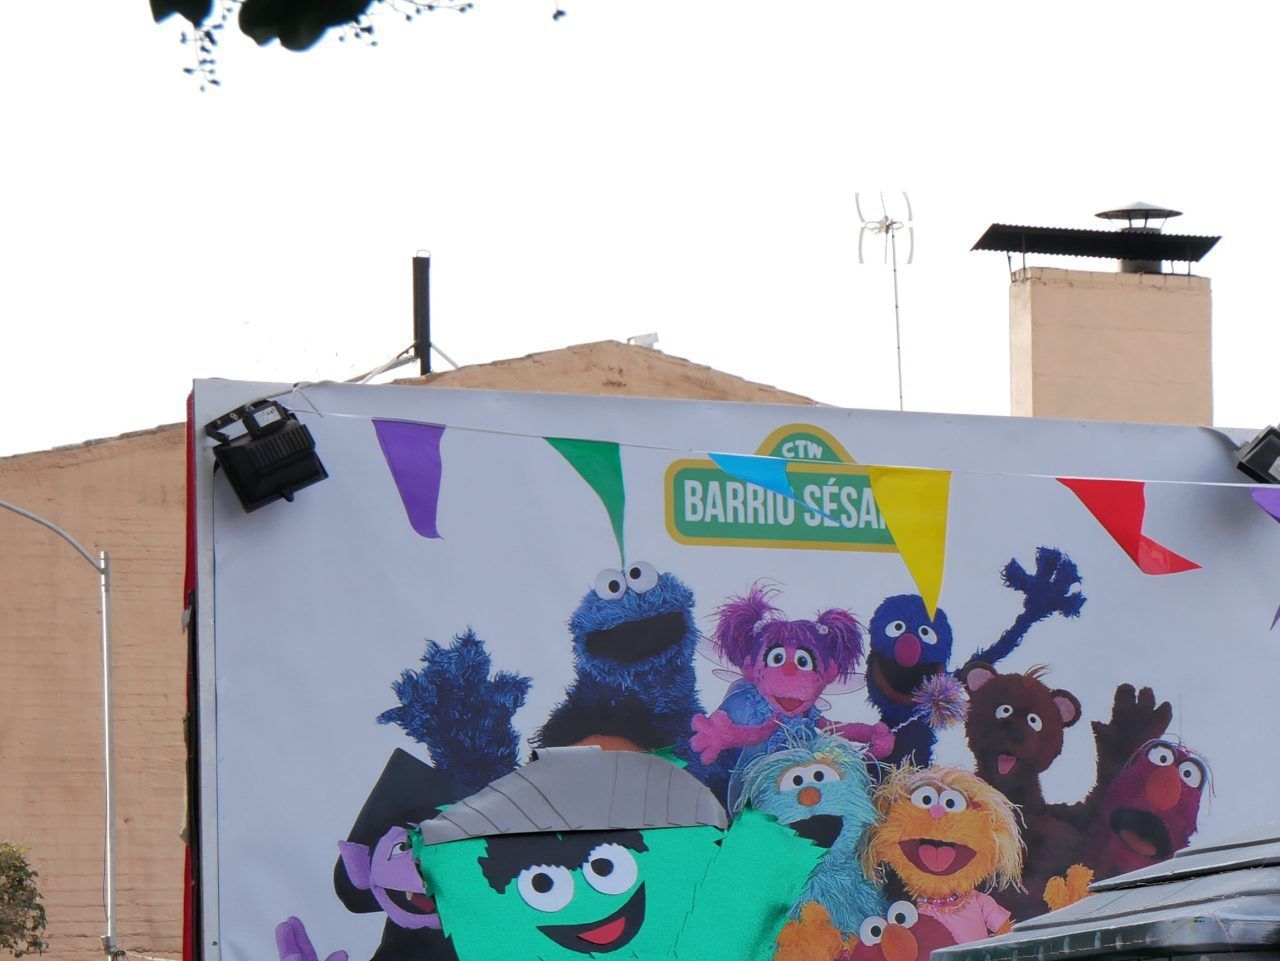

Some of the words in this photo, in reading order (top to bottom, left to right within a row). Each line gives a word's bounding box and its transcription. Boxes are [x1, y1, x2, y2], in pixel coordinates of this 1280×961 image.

[781, 439, 823, 460] CTW
[684, 480, 795, 526] BARRIO
[803, 478, 886, 530] SÉSA
